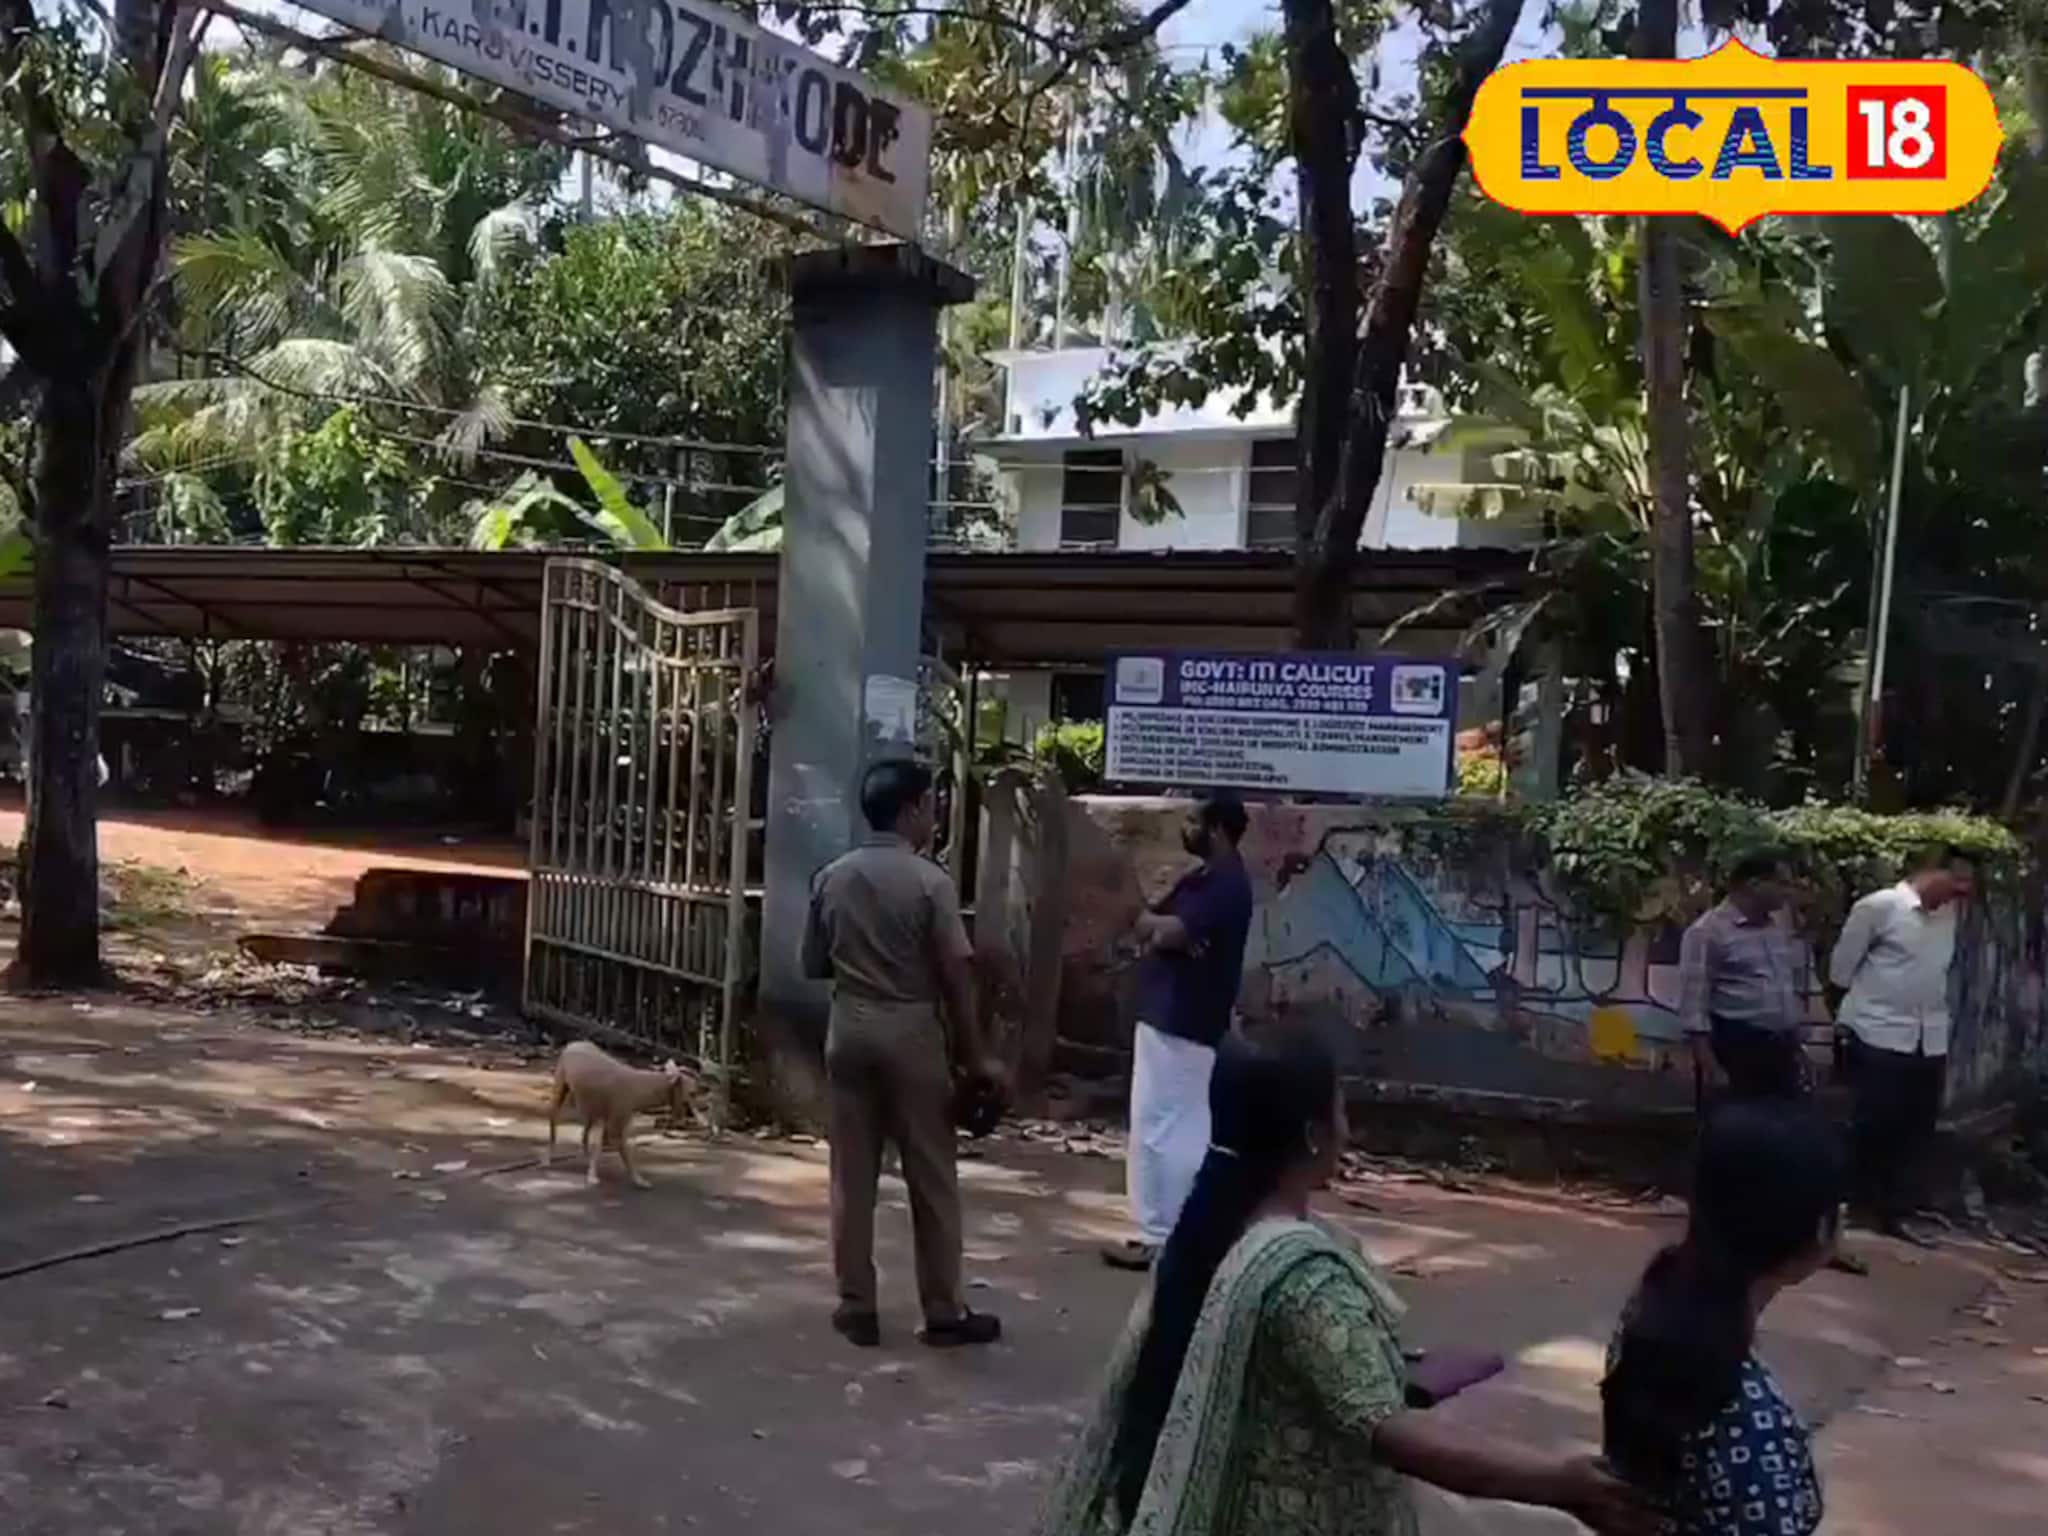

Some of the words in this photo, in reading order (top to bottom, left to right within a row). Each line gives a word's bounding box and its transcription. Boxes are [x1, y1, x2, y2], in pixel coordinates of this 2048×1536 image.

[1180, 660, 1245, 680] GOVT:
[1280, 663, 1375, 684] CALICUT
[1297, 683, 1374, 700] COURSES
